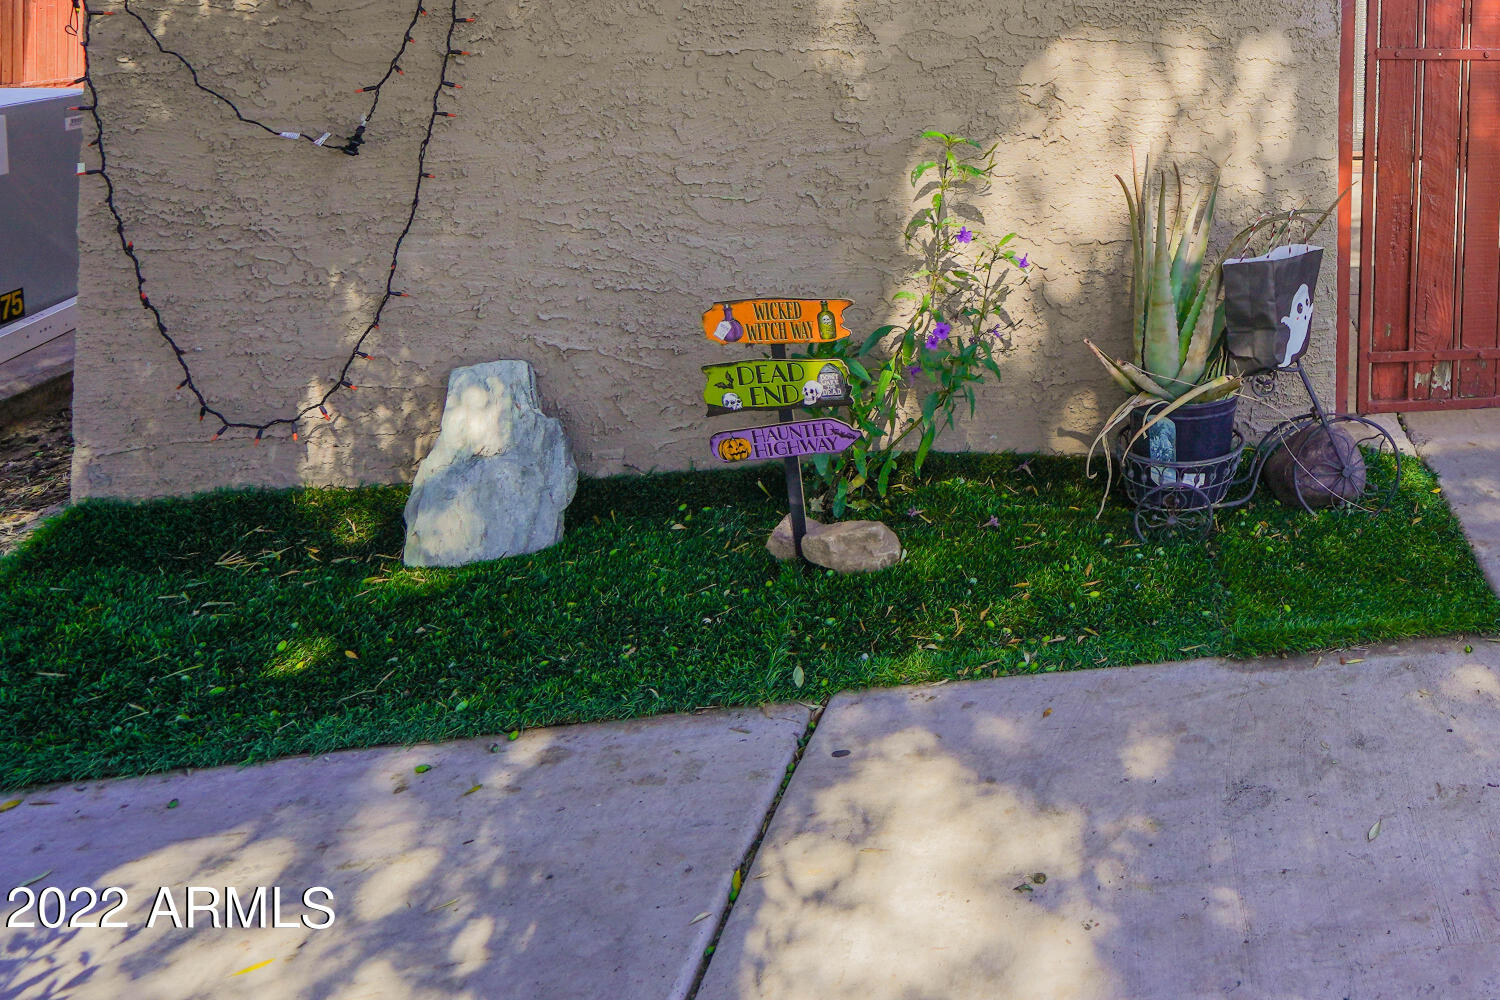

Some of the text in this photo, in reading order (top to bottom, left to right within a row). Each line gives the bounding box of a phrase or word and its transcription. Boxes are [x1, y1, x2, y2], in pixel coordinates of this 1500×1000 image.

[752, 301, 802, 320] WICKED
[744, 320, 788, 341] WITCH
[789, 320, 814, 340] WAY
[736, 362, 805, 386] DEAD
[749, 384, 799, 406] END
[751, 421, 835, 444] HAUNTED
[753, 436, 838, 458] HIGHWAY
